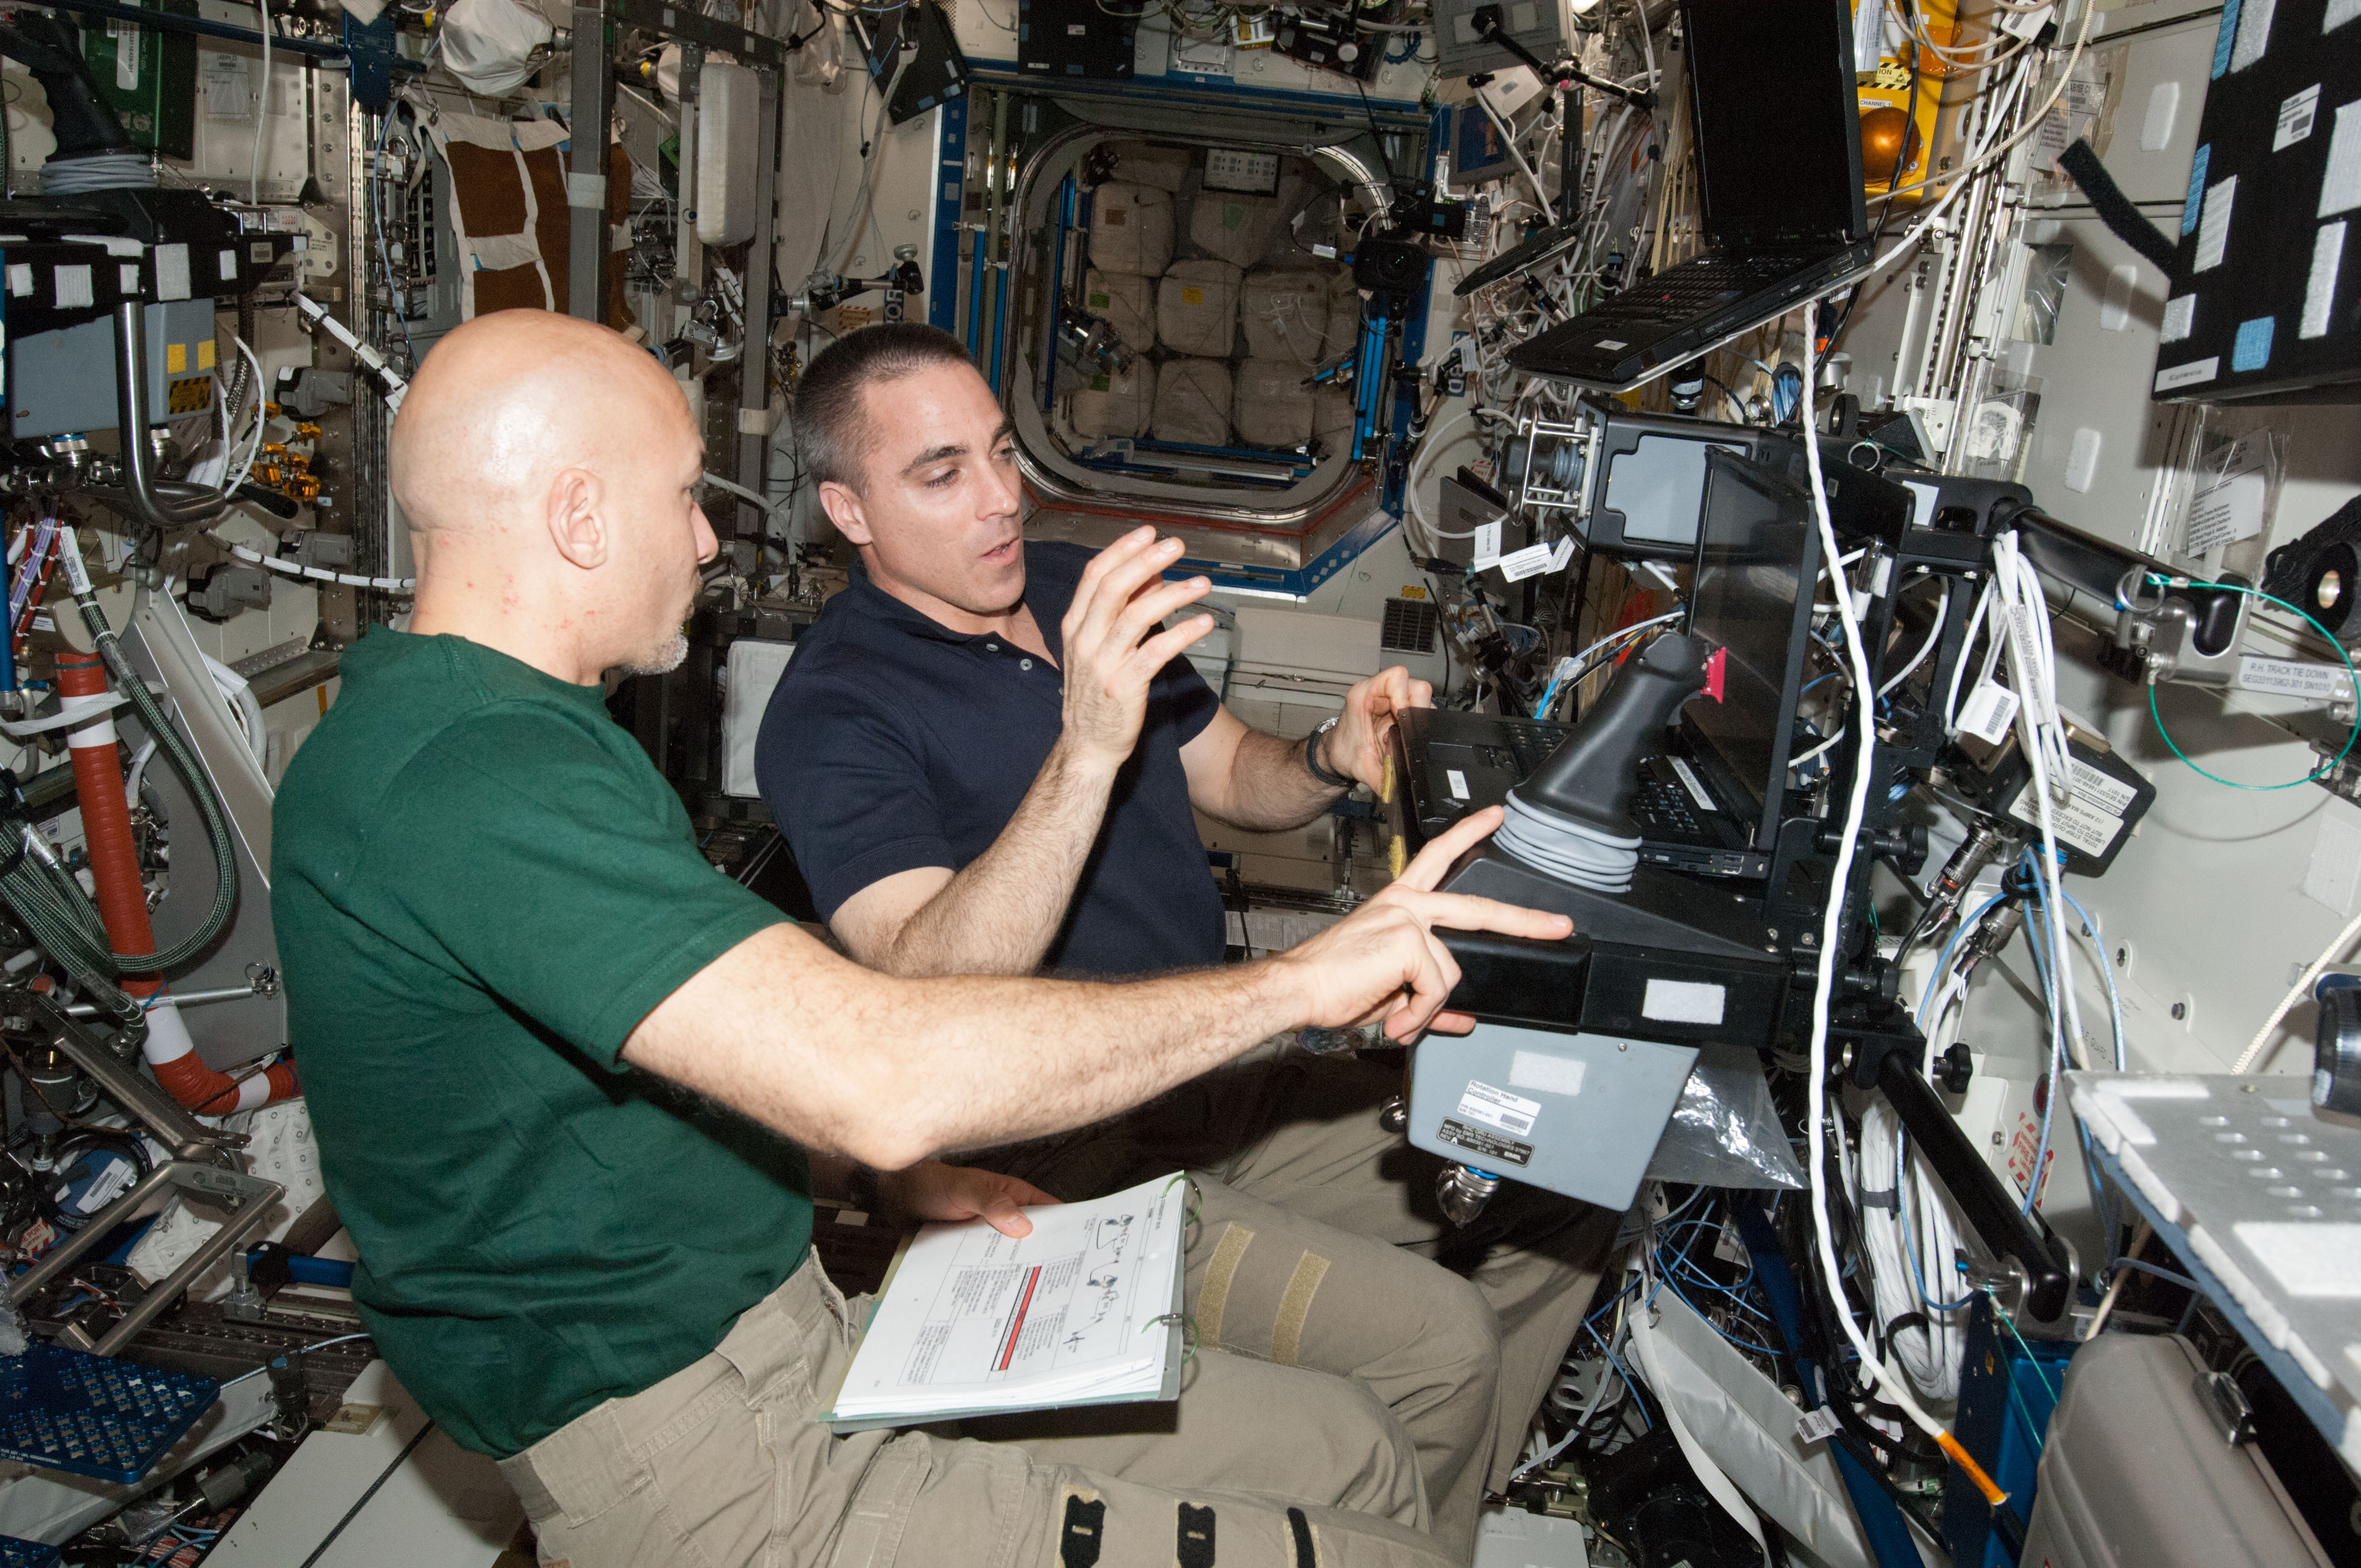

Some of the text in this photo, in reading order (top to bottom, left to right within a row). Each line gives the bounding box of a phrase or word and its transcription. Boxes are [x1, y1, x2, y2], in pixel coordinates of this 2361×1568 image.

[1449, 335, 1467, 394] SBD
[2018, 606, 2032, 639] Enhanced
[2267, 665, 2291, 676] TRACK
[2293, 667, 2304, 677] TIE
[2305, 669, 2329, 679] DOWN
[2047, 792, 2065, 805] OUTLE
[2086, 795, 2106, 808] Junction
[2108, 787, 2131, 802] S/N 1011
[2019, 798, 2039, 812] RATING
[2067, 802, 2080, 813] MAX
[2117, 798, 2128, 807] P/N
[2048, 813, 2061, 823] SOU
[2051, 808, 2073, 822] EXCEED
[2079, 809, 2096, 820] AMPS
[2050, 821, 2066, 832] OUTP
[2061, 819, 2077, 831] INPUT
[2080, 823, 2092, 832] NOT
[2065, 829, 2081, 840] STRIP
[2084, 831, 2106, 846] LIMITED
[2091, 828, 2103, 837] BUT
[2081, 837, 2098, 848] TOTAL
[2091, 1038, 2107, 1059] GUARD
[1468, 1087, 1501, 1104] Controller
[1471, 1081, 1519, 1102] Rotation Hand
[1442, 1129, 1455, 1137] ASSY
[1444, 1123, 1455, 1131] MFD
[1462, 1130, 1474, 1139] EMS
[1475, 1134, 1514, 1151] TECHNOLOGIES
[1462, 1125, 1515, 1145] RHC ORU ASSEMBLY
[2018, 1141, 2030, 1161] FIRE
[26, 1224, 43, 1239] PORT
